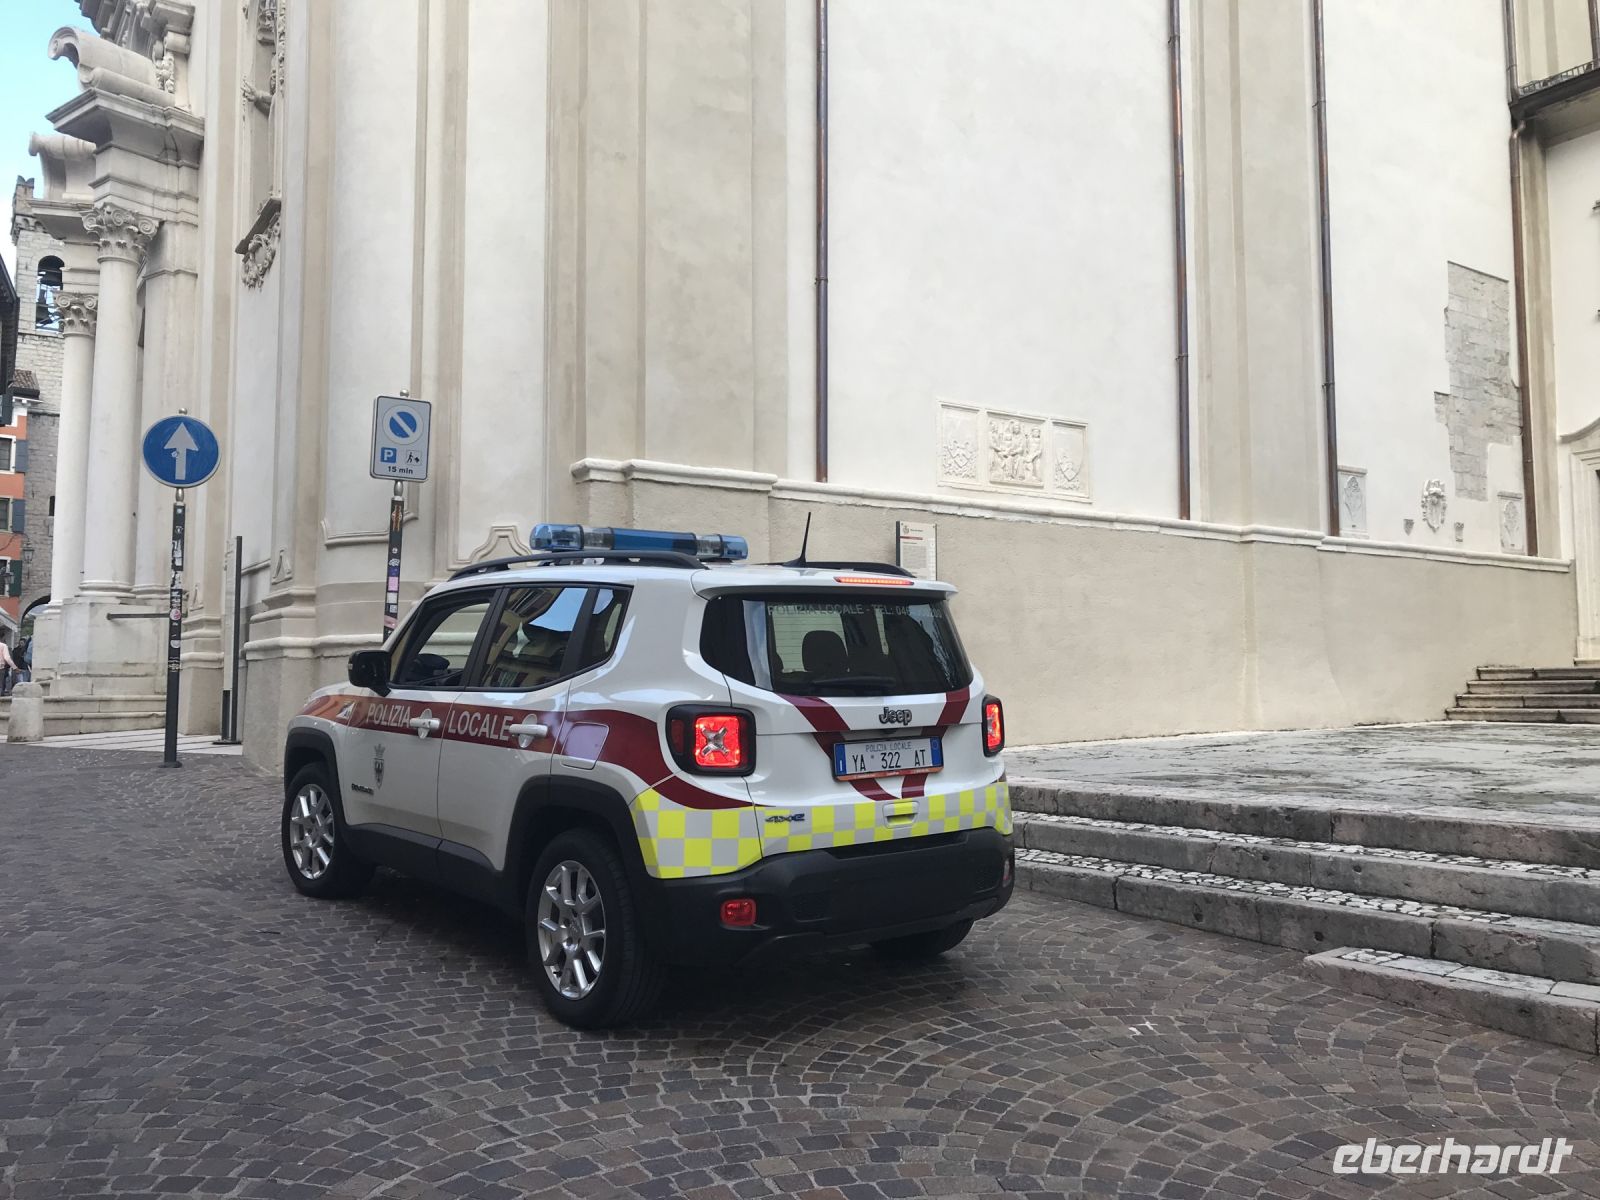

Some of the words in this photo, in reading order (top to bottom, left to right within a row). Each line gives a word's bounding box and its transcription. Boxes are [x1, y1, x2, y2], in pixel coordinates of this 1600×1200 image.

[384, 449, 394, 461] P
[398, 467, 413, 475] min
[767, 603, 814, 616] POLIZIA
[816, 603, 864, 616] LOCALE
[366, 702, 411, 728] POLIZIA
[448, 710, 514, 742] LOCALE
[879, 706, 912, 726] Jeep
[865, 743, 887, 753] POLIZIA
[890, 741, 911, 751] LOCALE
[852, 754, 866, 772] YA
[881, 751, 901, 769] 322
[914, 749, 926, 766] AT
